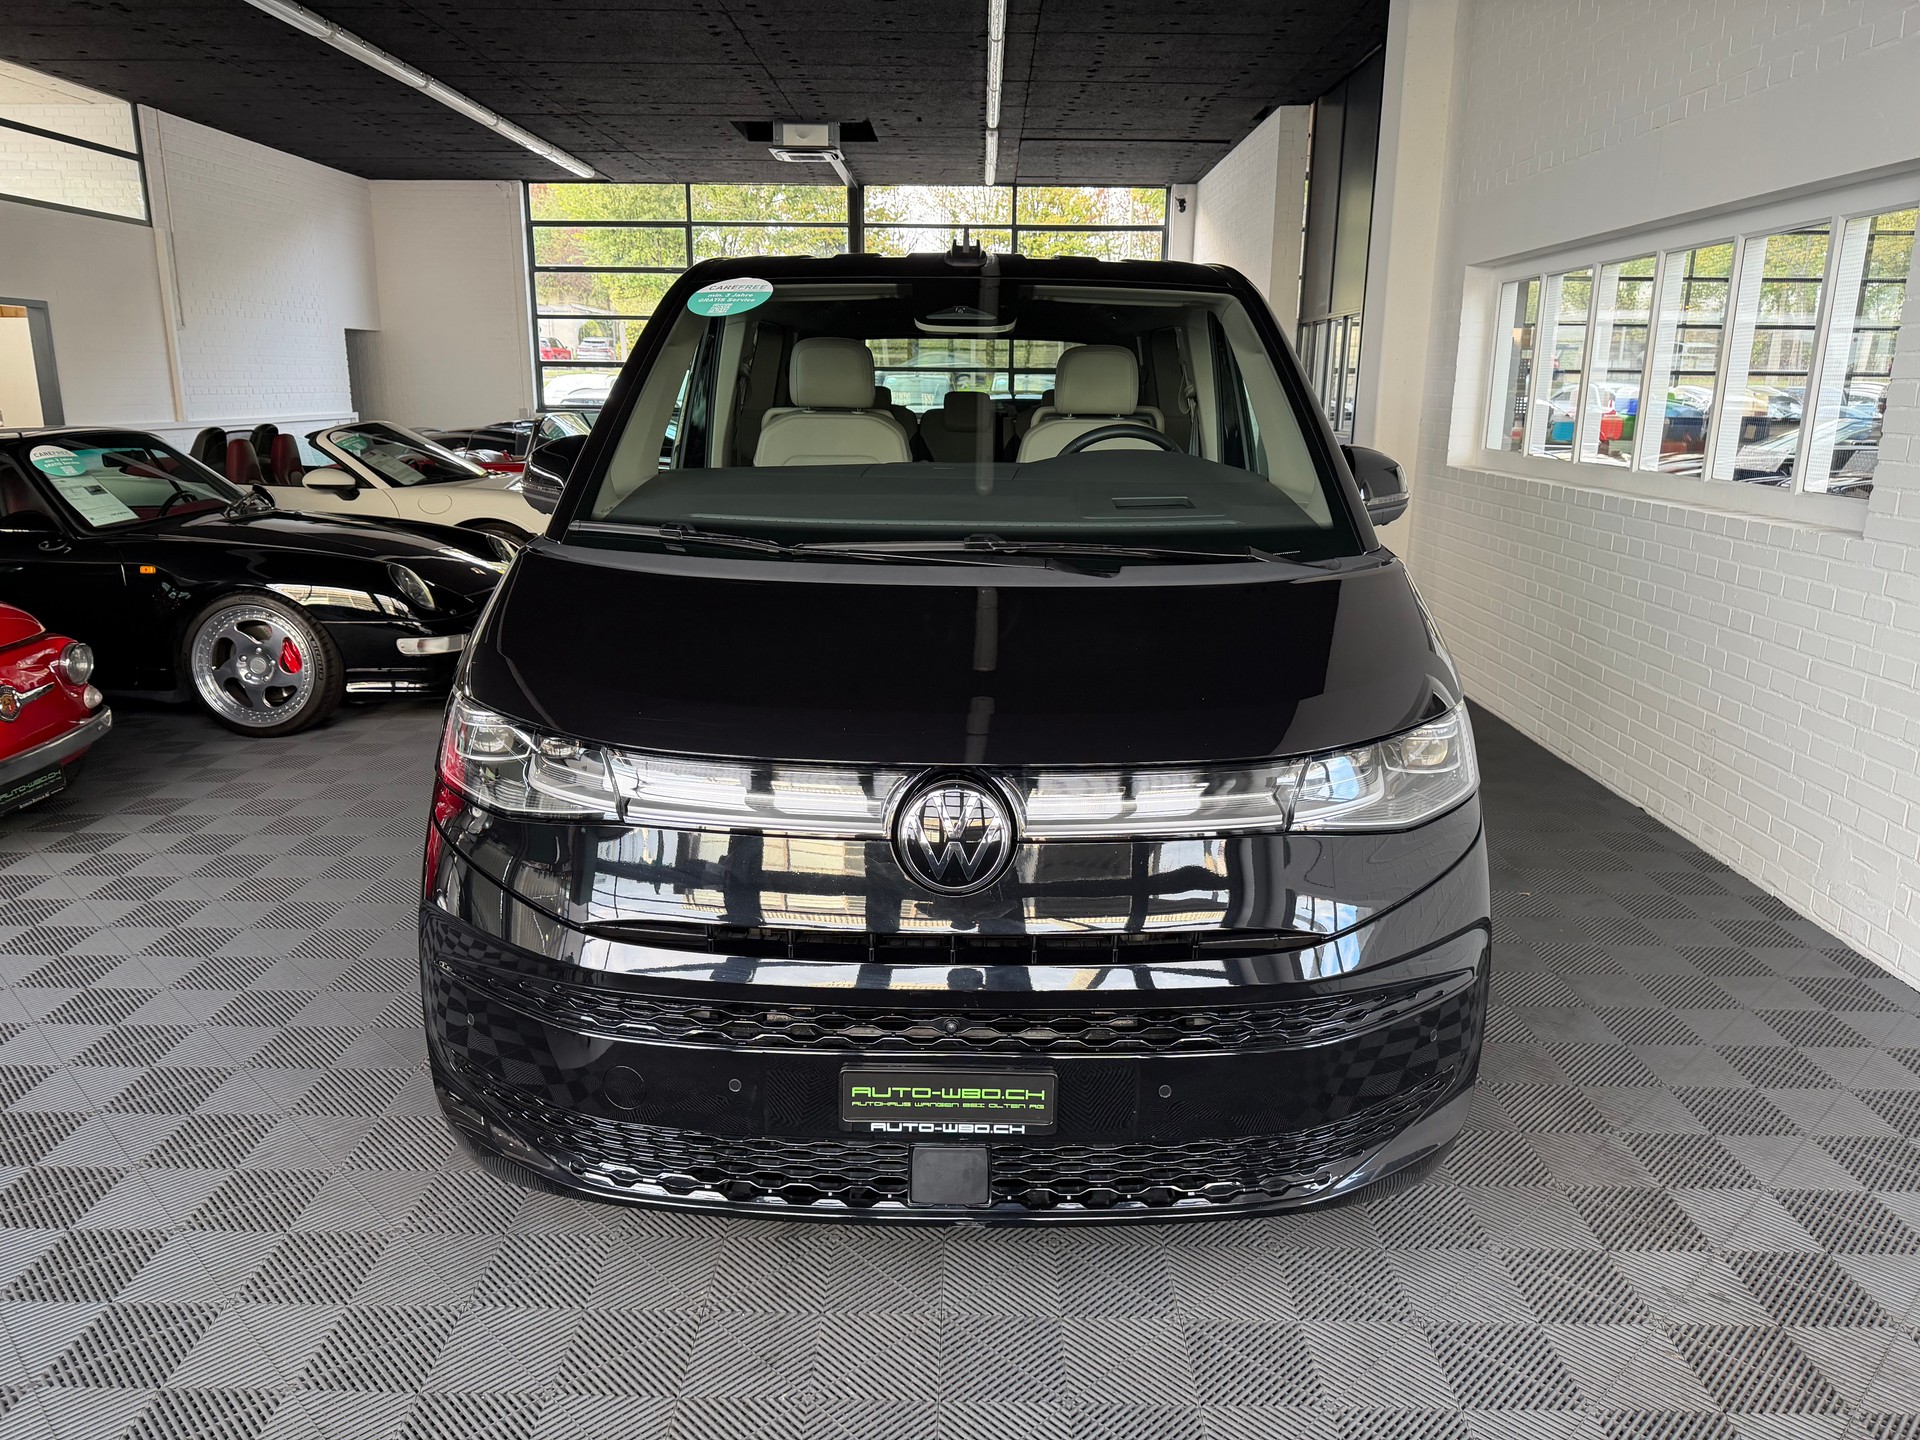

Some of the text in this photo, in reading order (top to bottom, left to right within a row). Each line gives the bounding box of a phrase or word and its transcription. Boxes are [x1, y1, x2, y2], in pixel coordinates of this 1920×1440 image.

[904, 789, 1004, 881] VW
[851, 1086, 1045, 1101] AUTO-WBO.CH
[870, 1122, 1026, 1135] AUTO-WBO.CH
